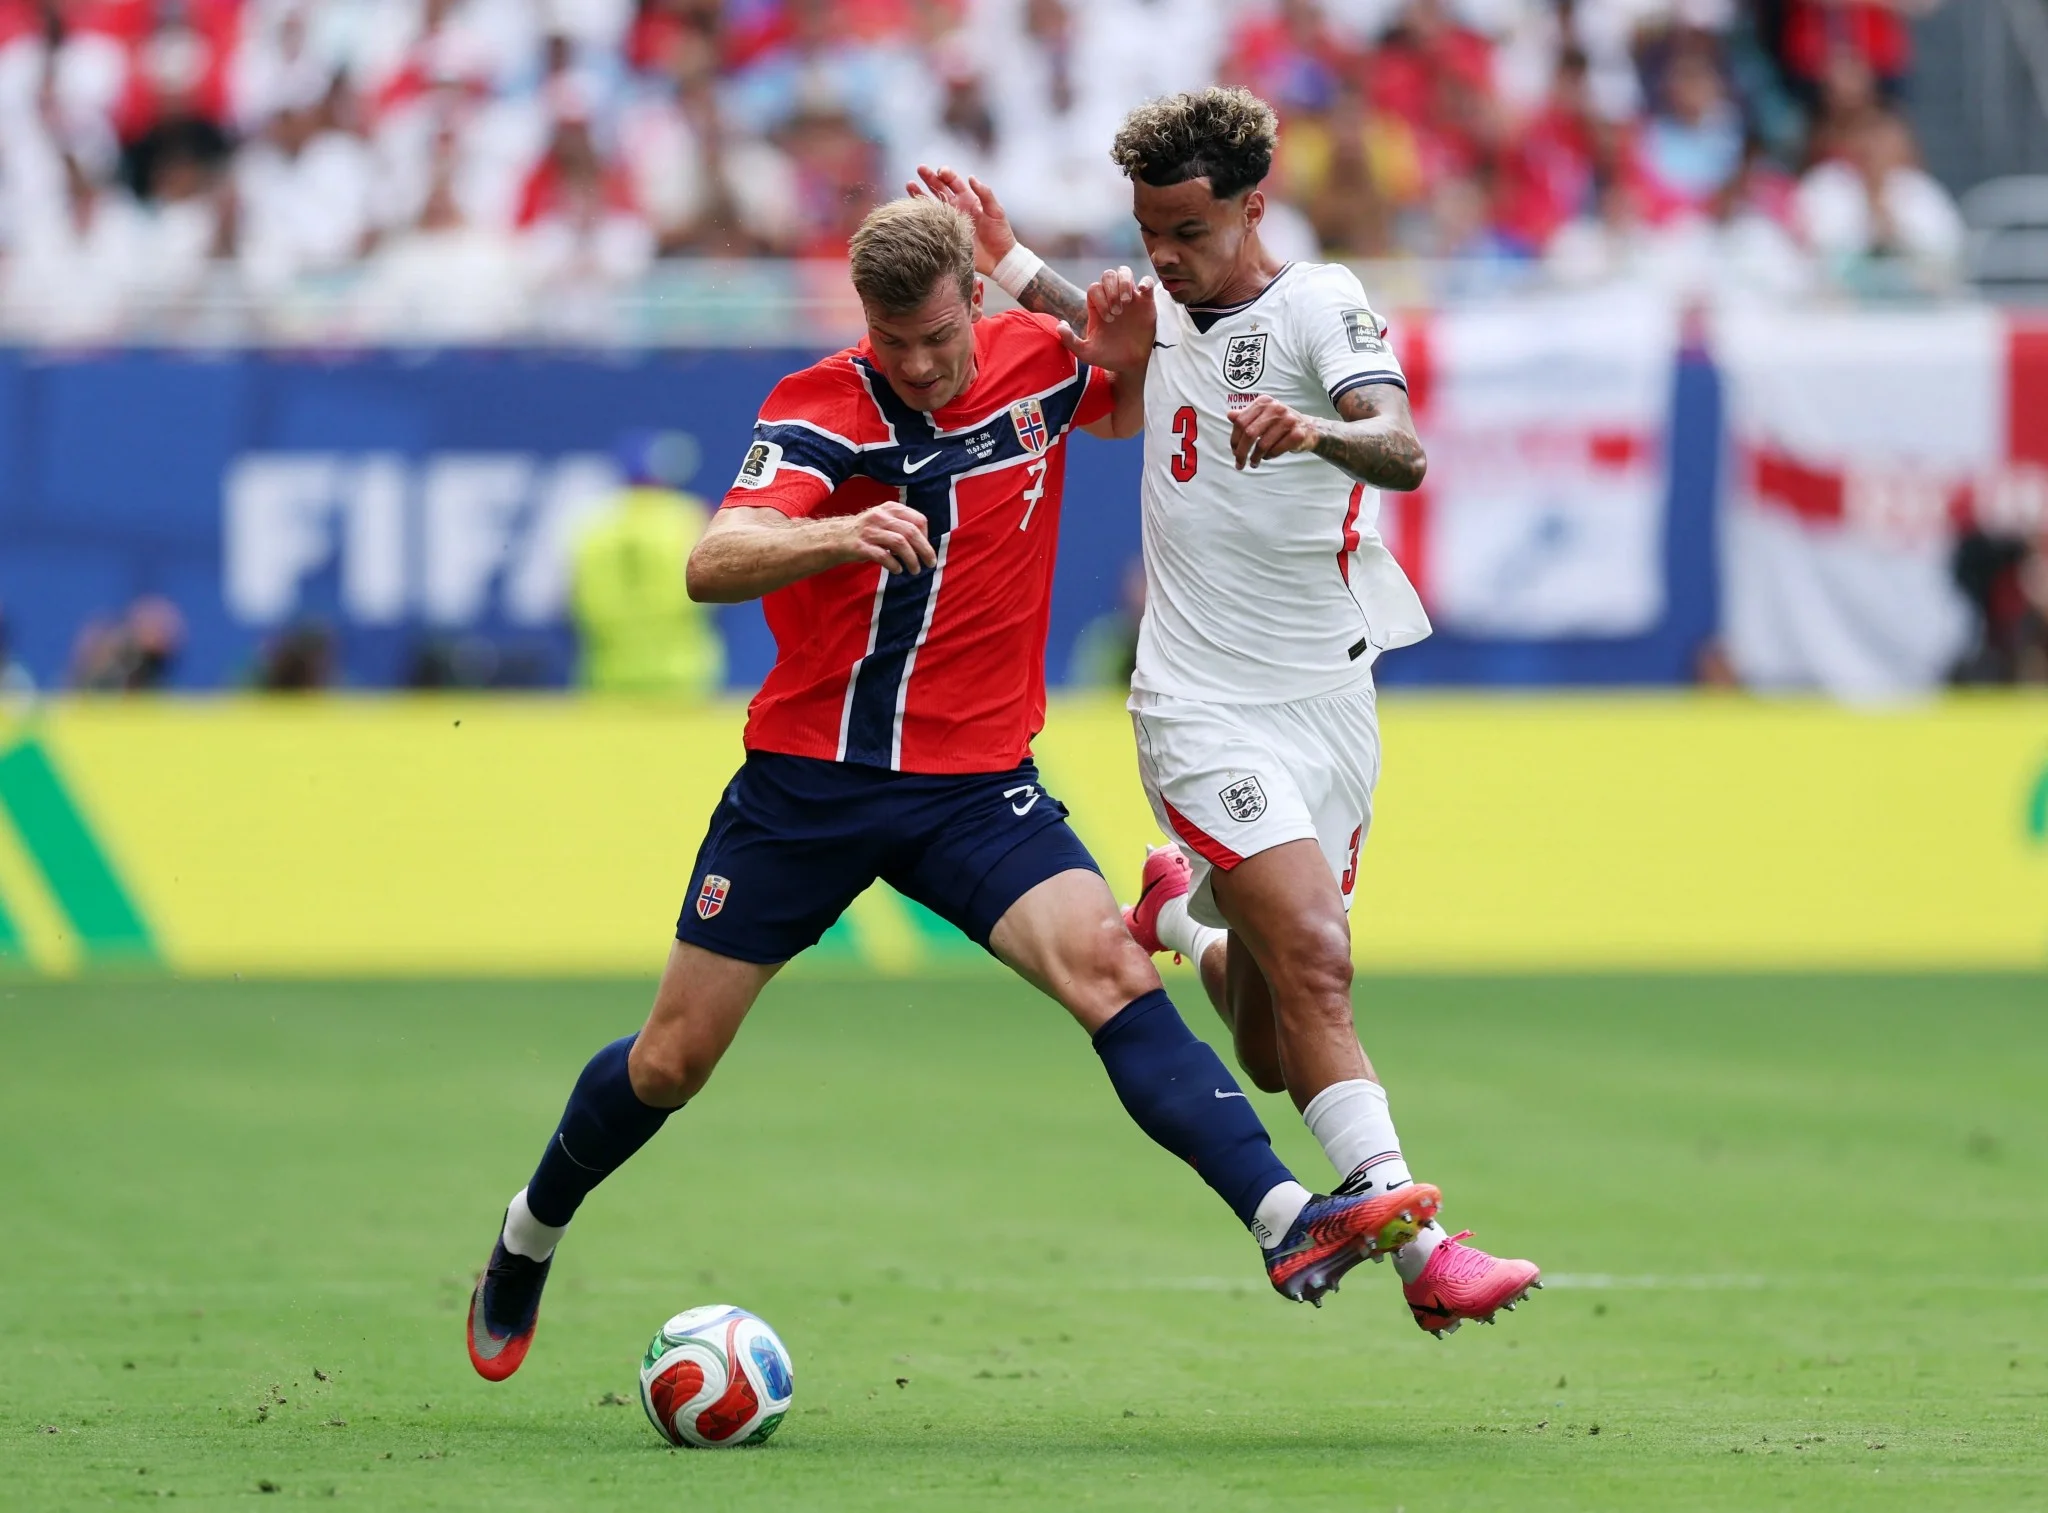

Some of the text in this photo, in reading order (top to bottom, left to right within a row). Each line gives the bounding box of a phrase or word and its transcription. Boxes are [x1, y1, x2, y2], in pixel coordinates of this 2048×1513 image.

[1227, 393, 1259, 403] NORWAY
[1171, 405, 1198, 483] 3
[1019, 458, 1048, 532] 7
[1340, 823, 1363, 896] 3
